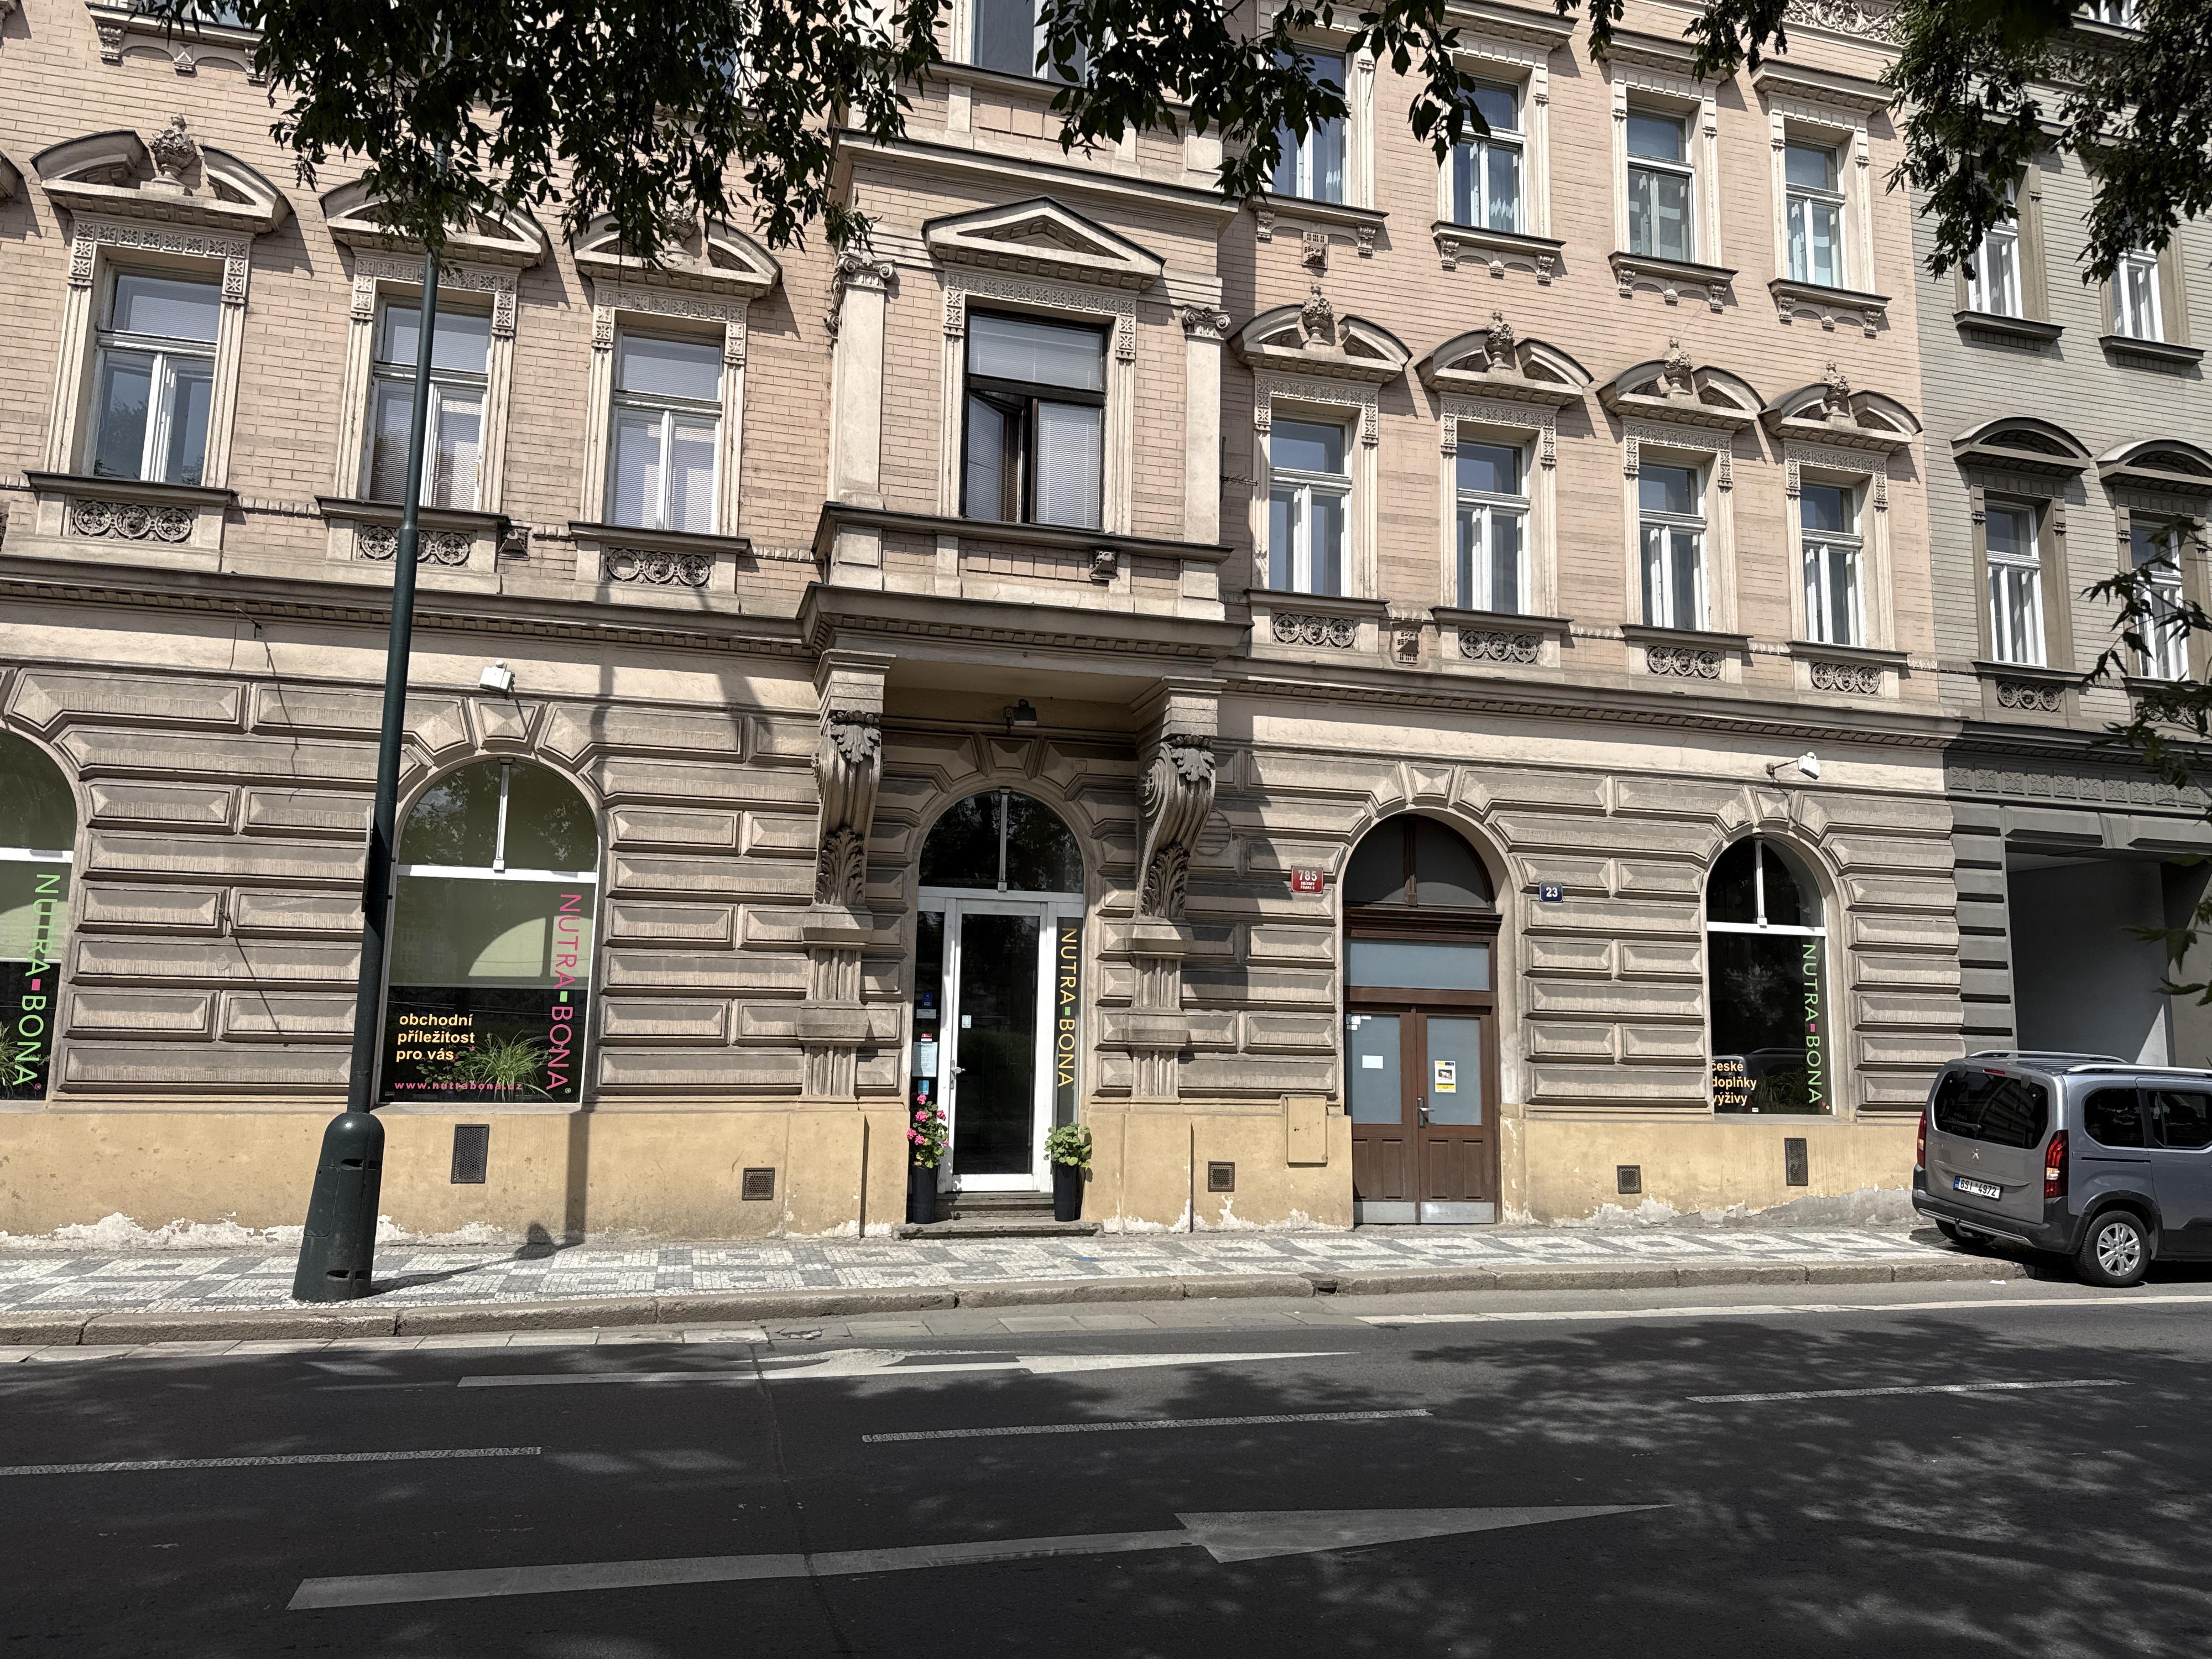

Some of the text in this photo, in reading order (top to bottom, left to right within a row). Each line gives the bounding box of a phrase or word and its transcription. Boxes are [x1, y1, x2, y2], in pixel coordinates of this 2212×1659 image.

[1298, 869, 1317, 881] 785
[1546, 886, 1558, 898] 23
[399, 1013, 473, 1026] obchodní
[397, 1030, 475, 1045] příležitost
[396, 1048, 455, 1063] pro vás
[1712, 1060, 1744, 1072] české
[394, 1080, 523, 1091] www.nutrabona.cz
[1712, 1076, 1757, 1091] doplňky
[1960, 1179, 1973, 1191] 6SI
[1978, 1184, 1996, 1197] 4972
